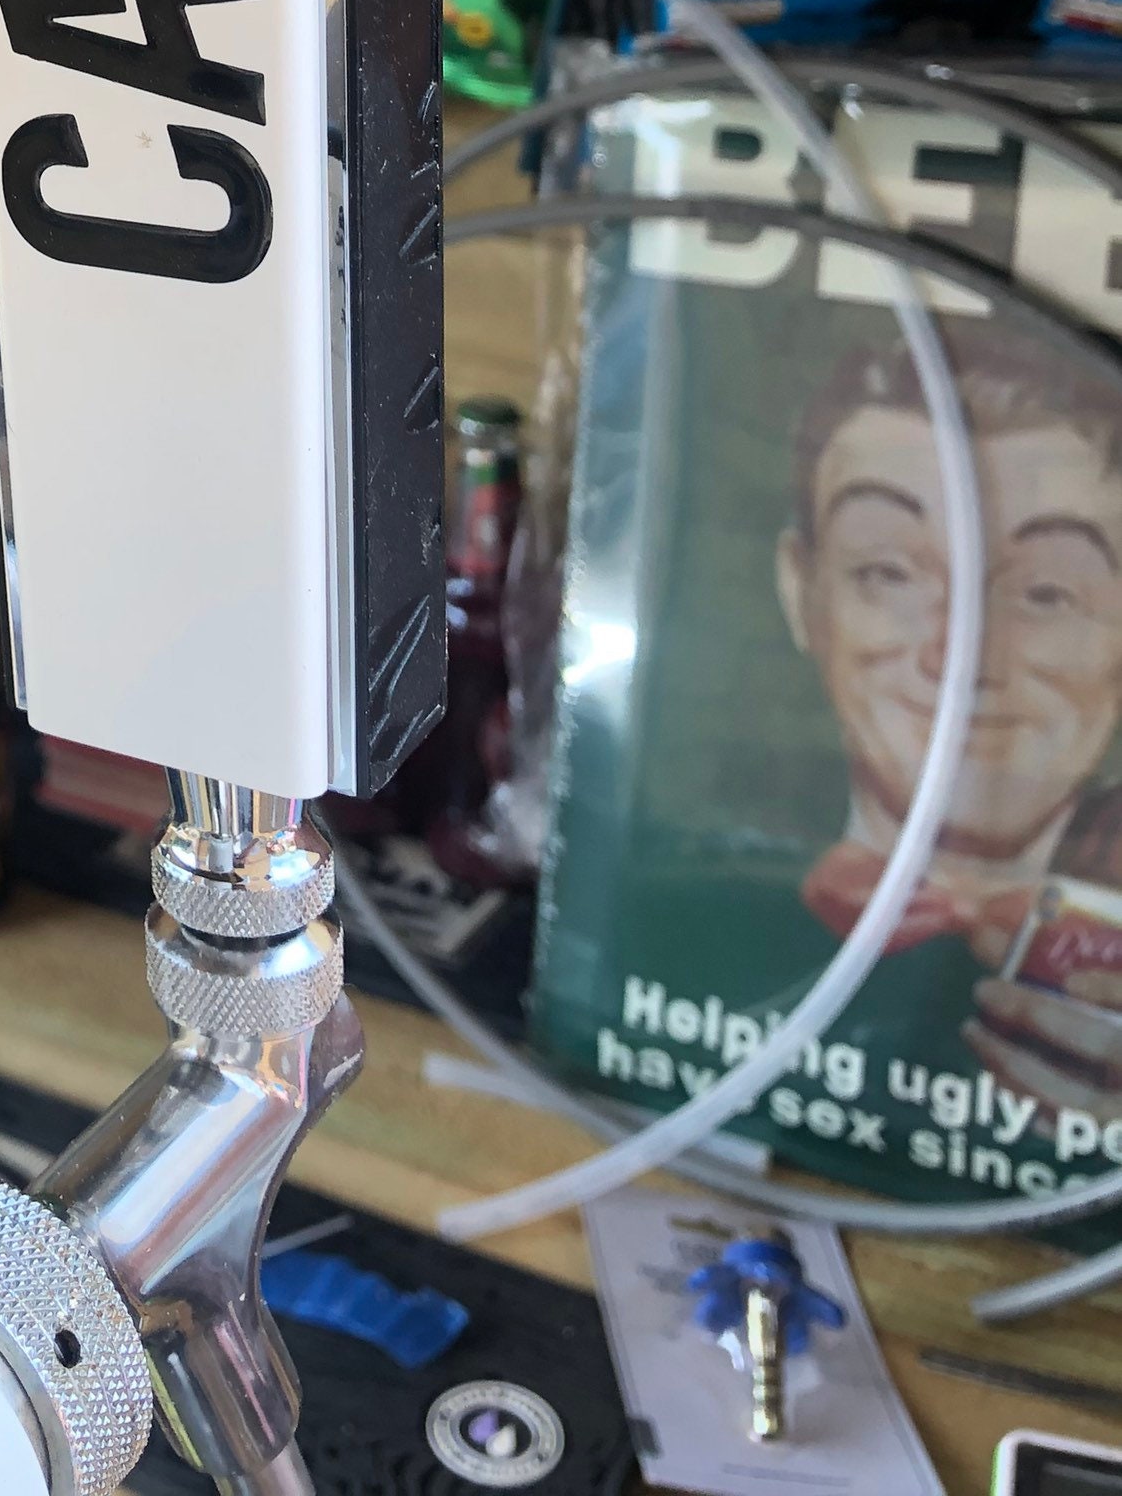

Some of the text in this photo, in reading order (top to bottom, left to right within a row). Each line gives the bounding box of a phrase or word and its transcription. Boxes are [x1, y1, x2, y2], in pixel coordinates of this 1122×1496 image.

[597, 1027, 756, 1114] hav
[770, 1086, 886, 1153] sex
[887, 1057, 1038, 1145] ugly
